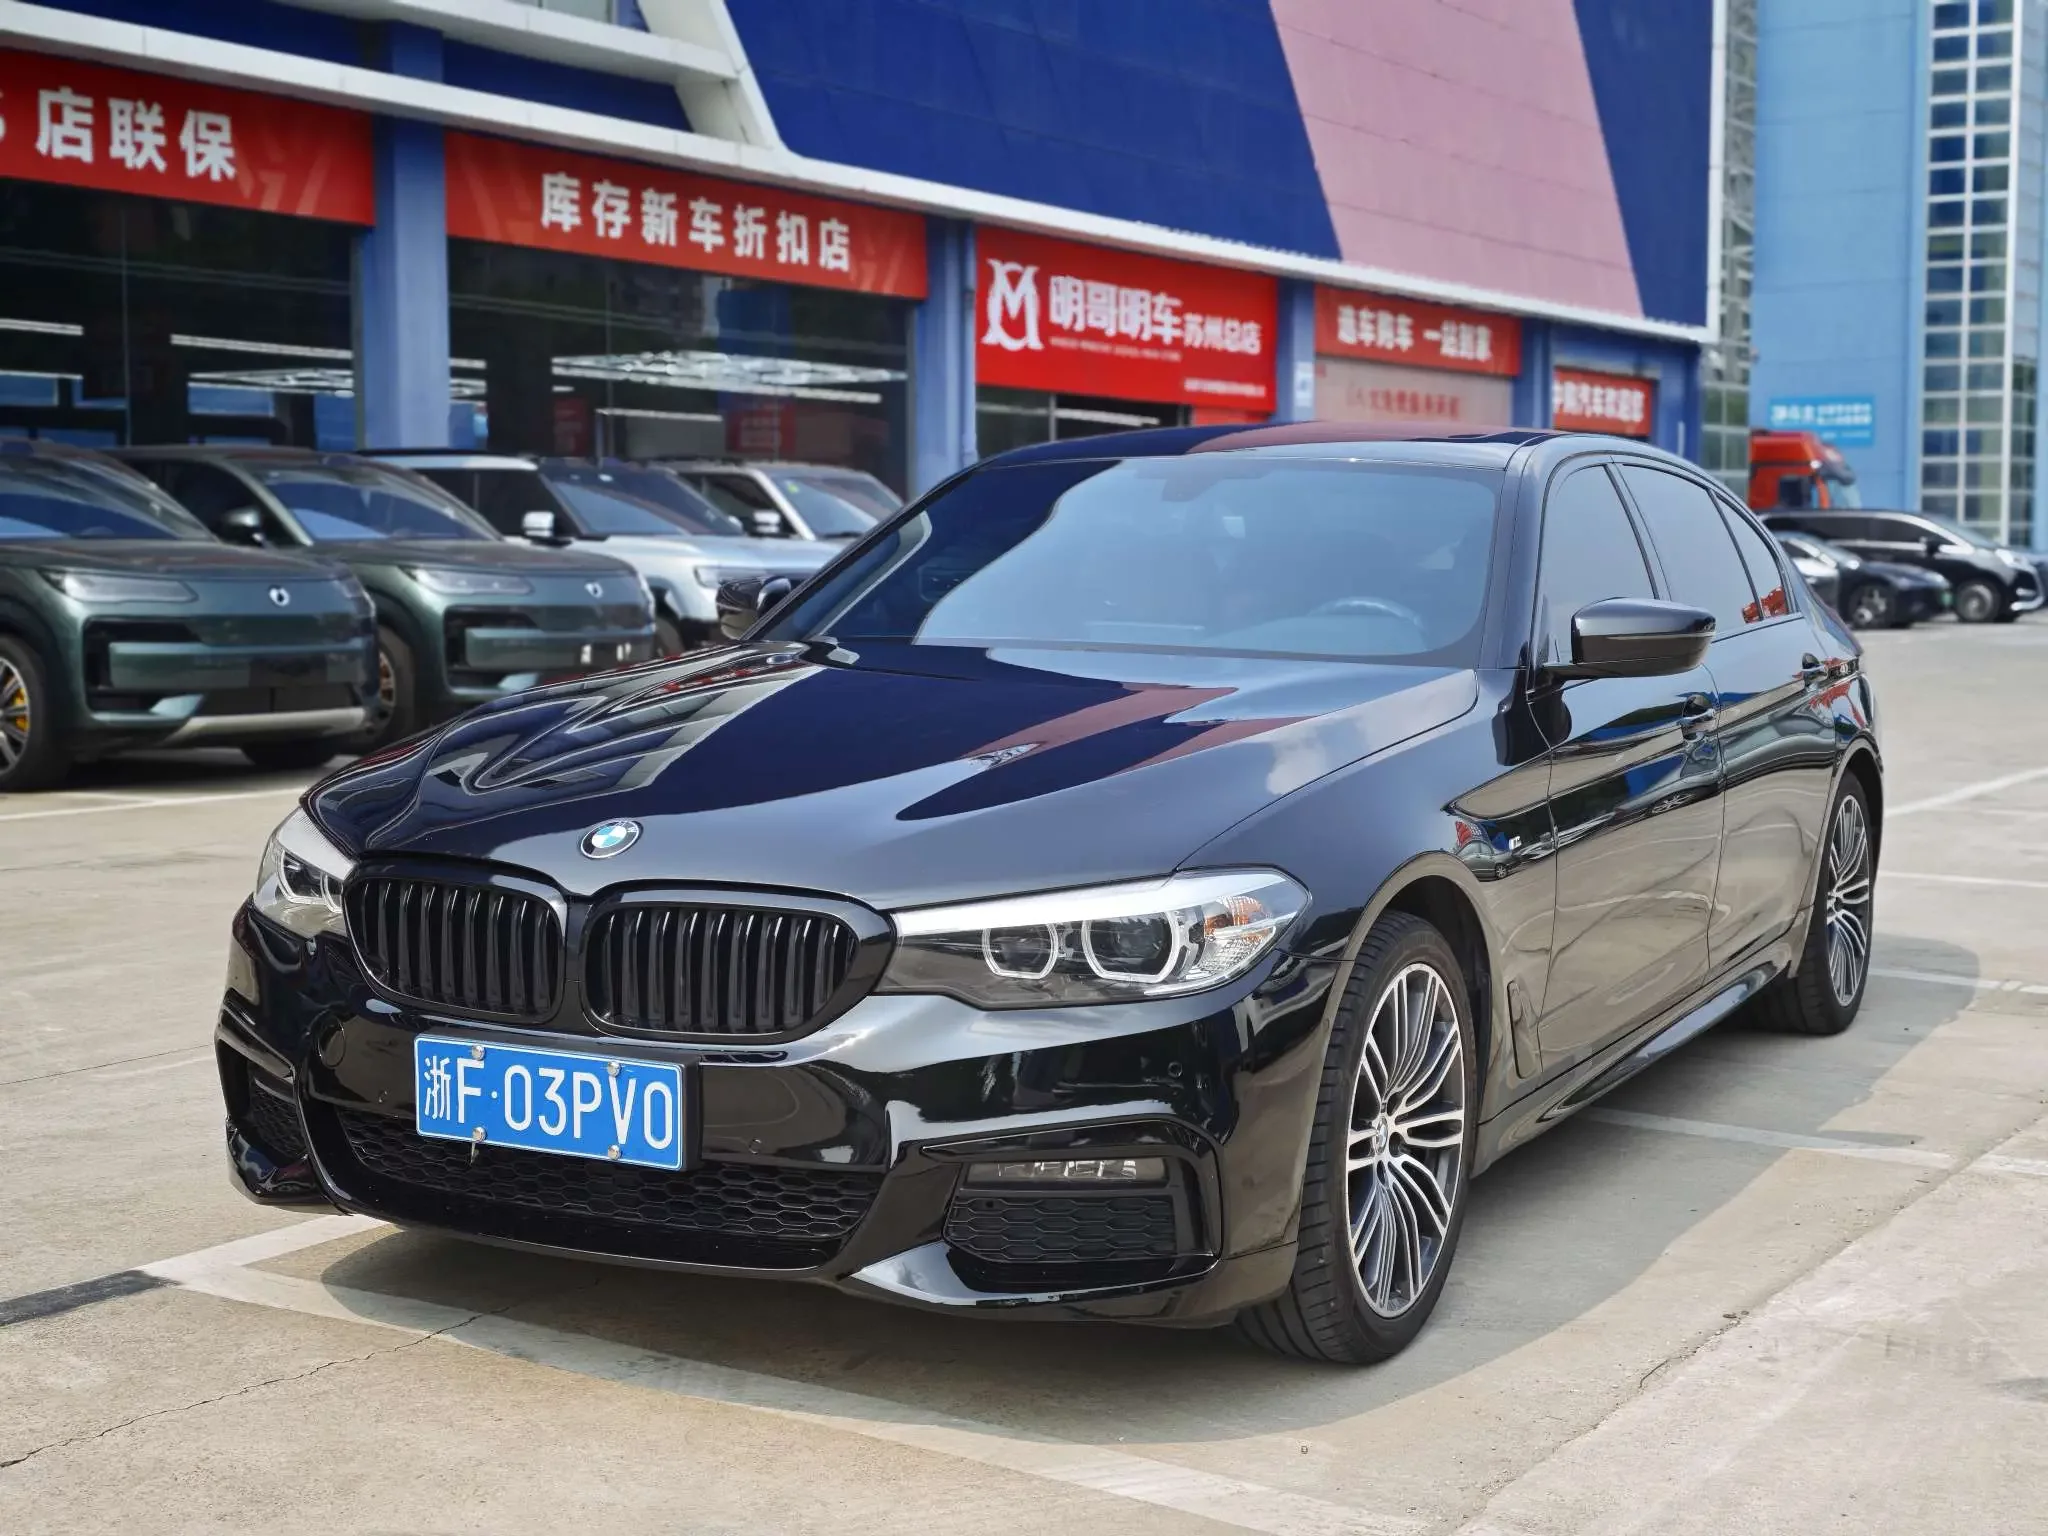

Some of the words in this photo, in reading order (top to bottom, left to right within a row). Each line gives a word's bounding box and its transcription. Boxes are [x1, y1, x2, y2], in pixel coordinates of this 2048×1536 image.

[0, 86, 236, 182] 店联保
[541, 171, 850, 272] 库存新车折扣店
[1049, 275, 1183, 346] 明哥明车
